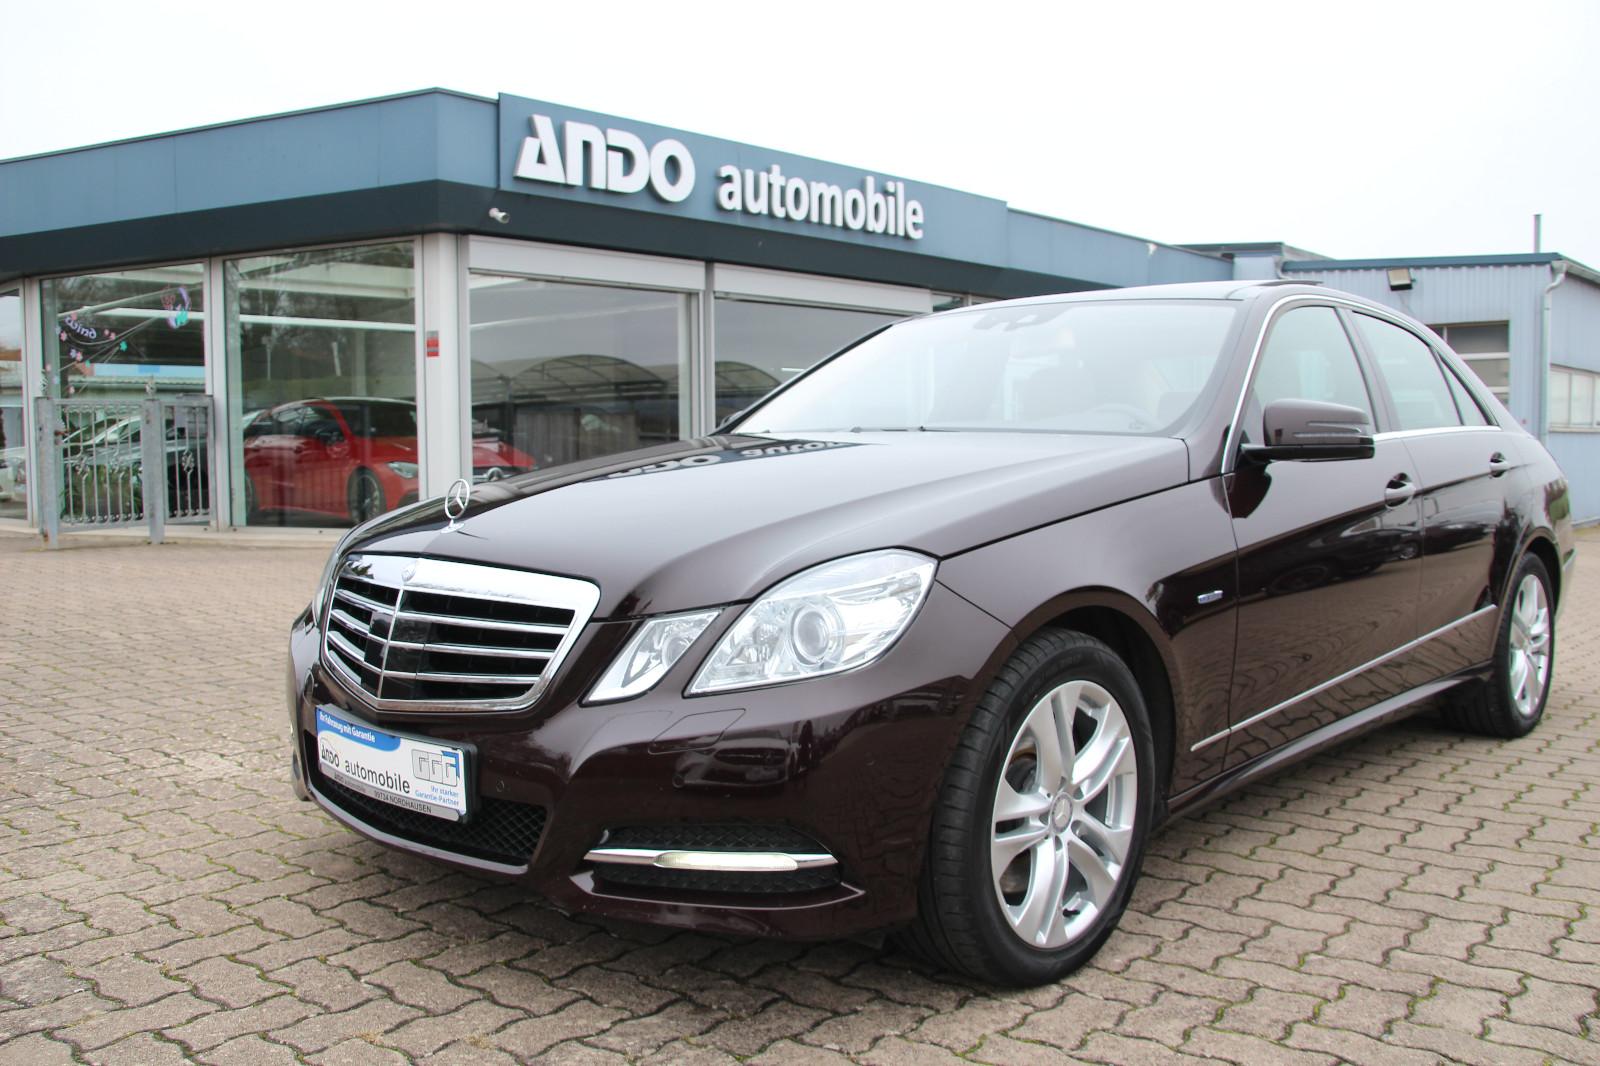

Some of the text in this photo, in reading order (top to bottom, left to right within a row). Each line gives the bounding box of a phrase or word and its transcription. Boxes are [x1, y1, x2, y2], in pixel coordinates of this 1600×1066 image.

[513, 113, 924, 240] ANDO automobile
[344, 759, 411, 794] automobile
[389, 794, 432, 814] NORDHAUSEN
